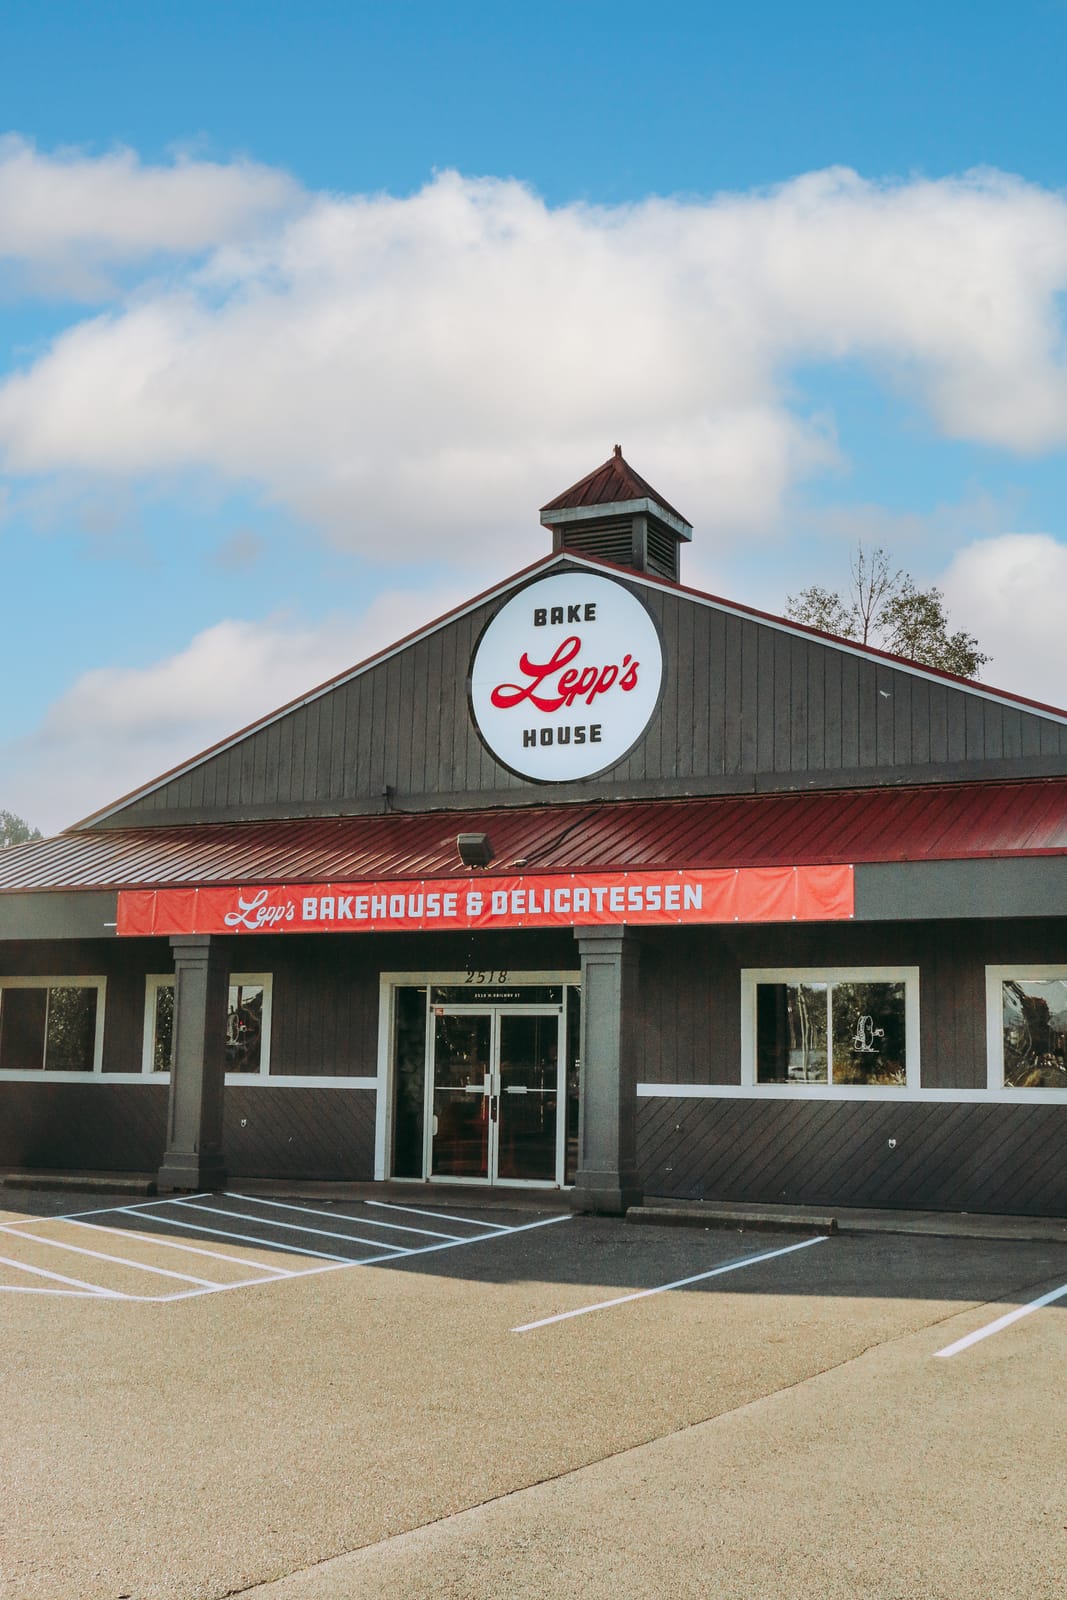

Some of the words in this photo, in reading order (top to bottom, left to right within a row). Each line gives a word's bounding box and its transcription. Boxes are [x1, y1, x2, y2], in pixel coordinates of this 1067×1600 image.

[534, 603, 596, 626] BAKE
[491, 636, 640, 712] Lepp's
[523, 724, 602, 747] HOUSE
[224, 889, 295, 929] Lepp's
[302, 893, 458, 921] BAKEHOUSE
[466, 891, 484, 916] &
[491, 884, 703, 915] DELICATESSEN
[465, 970, 508, 983] 2518
